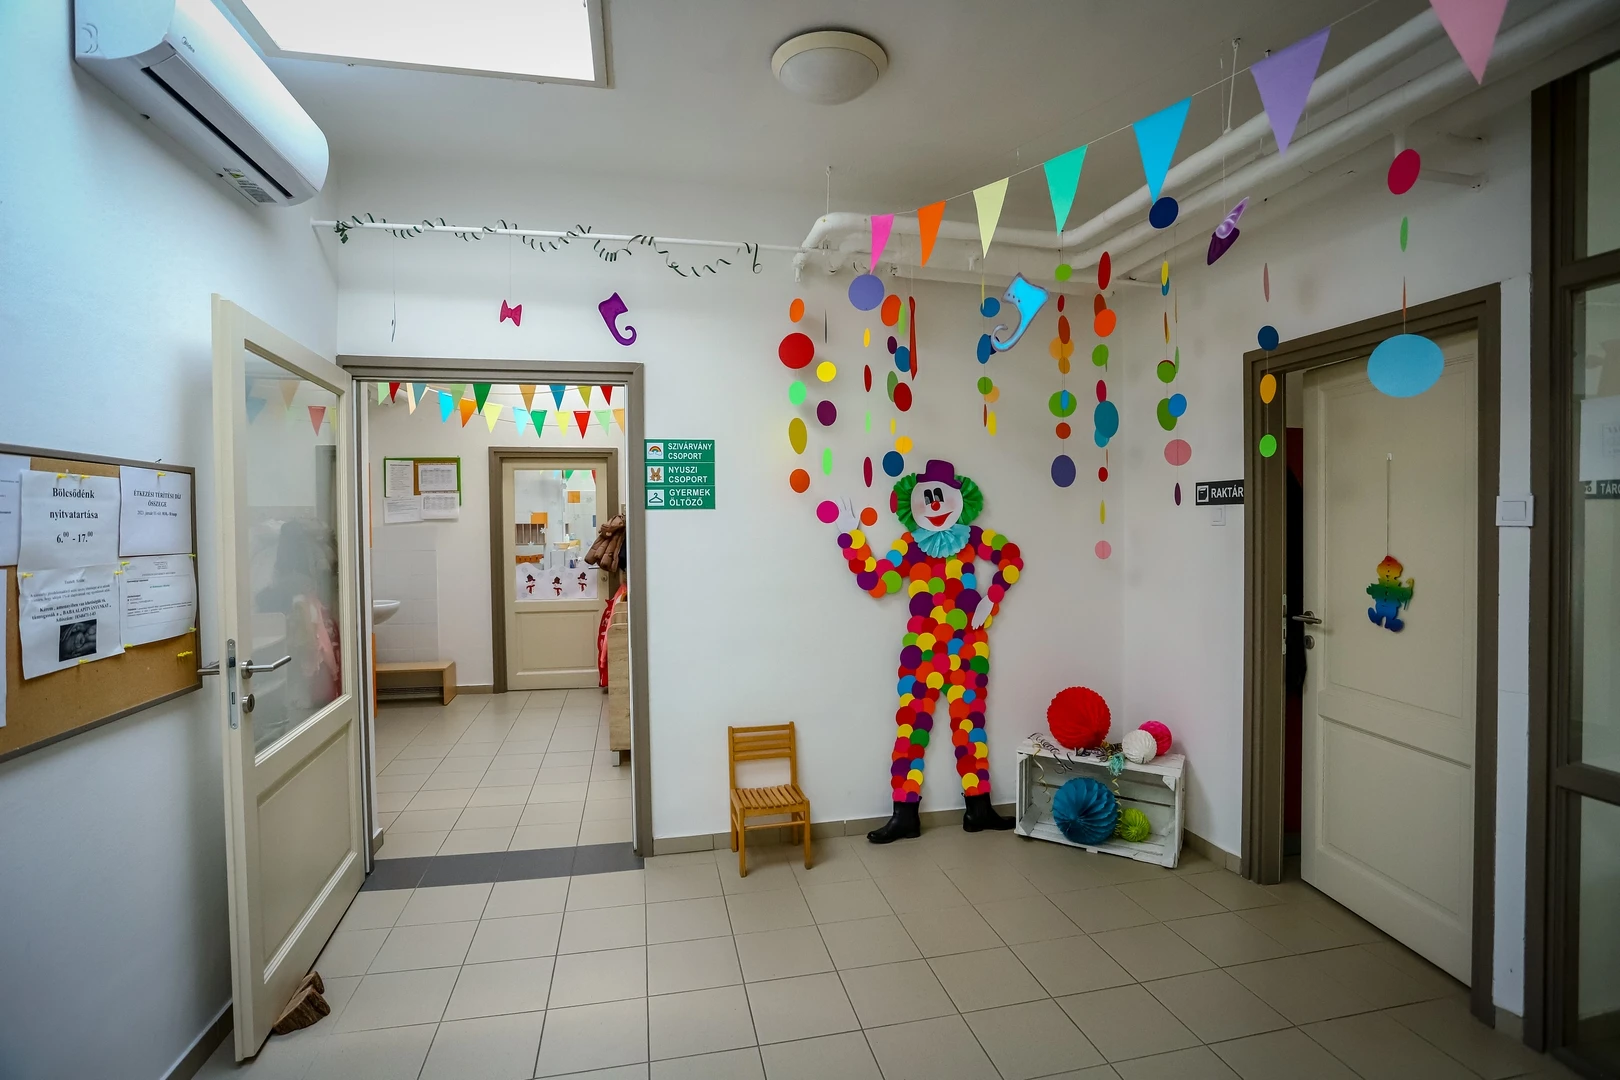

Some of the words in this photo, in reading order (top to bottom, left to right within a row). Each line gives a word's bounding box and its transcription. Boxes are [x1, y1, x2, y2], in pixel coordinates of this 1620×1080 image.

[667, 441, 713, 450] SZIVÁRVÁNY
[667, 452, 703, 460] CSOPORT
[668, 466, 698, 474] NYUSZI
[668, 475, 708, 483] CSOPORT
[52, 487, 95, 499] Bölcsődénk
[669, 488, 711, 497] GYERMEK
[1211, 484, 1244, 498] RAKTÁR
[669, 497, 703, 507] ÖLTÖZŐ
[49, 509, 99, 521] nyitvatartása
